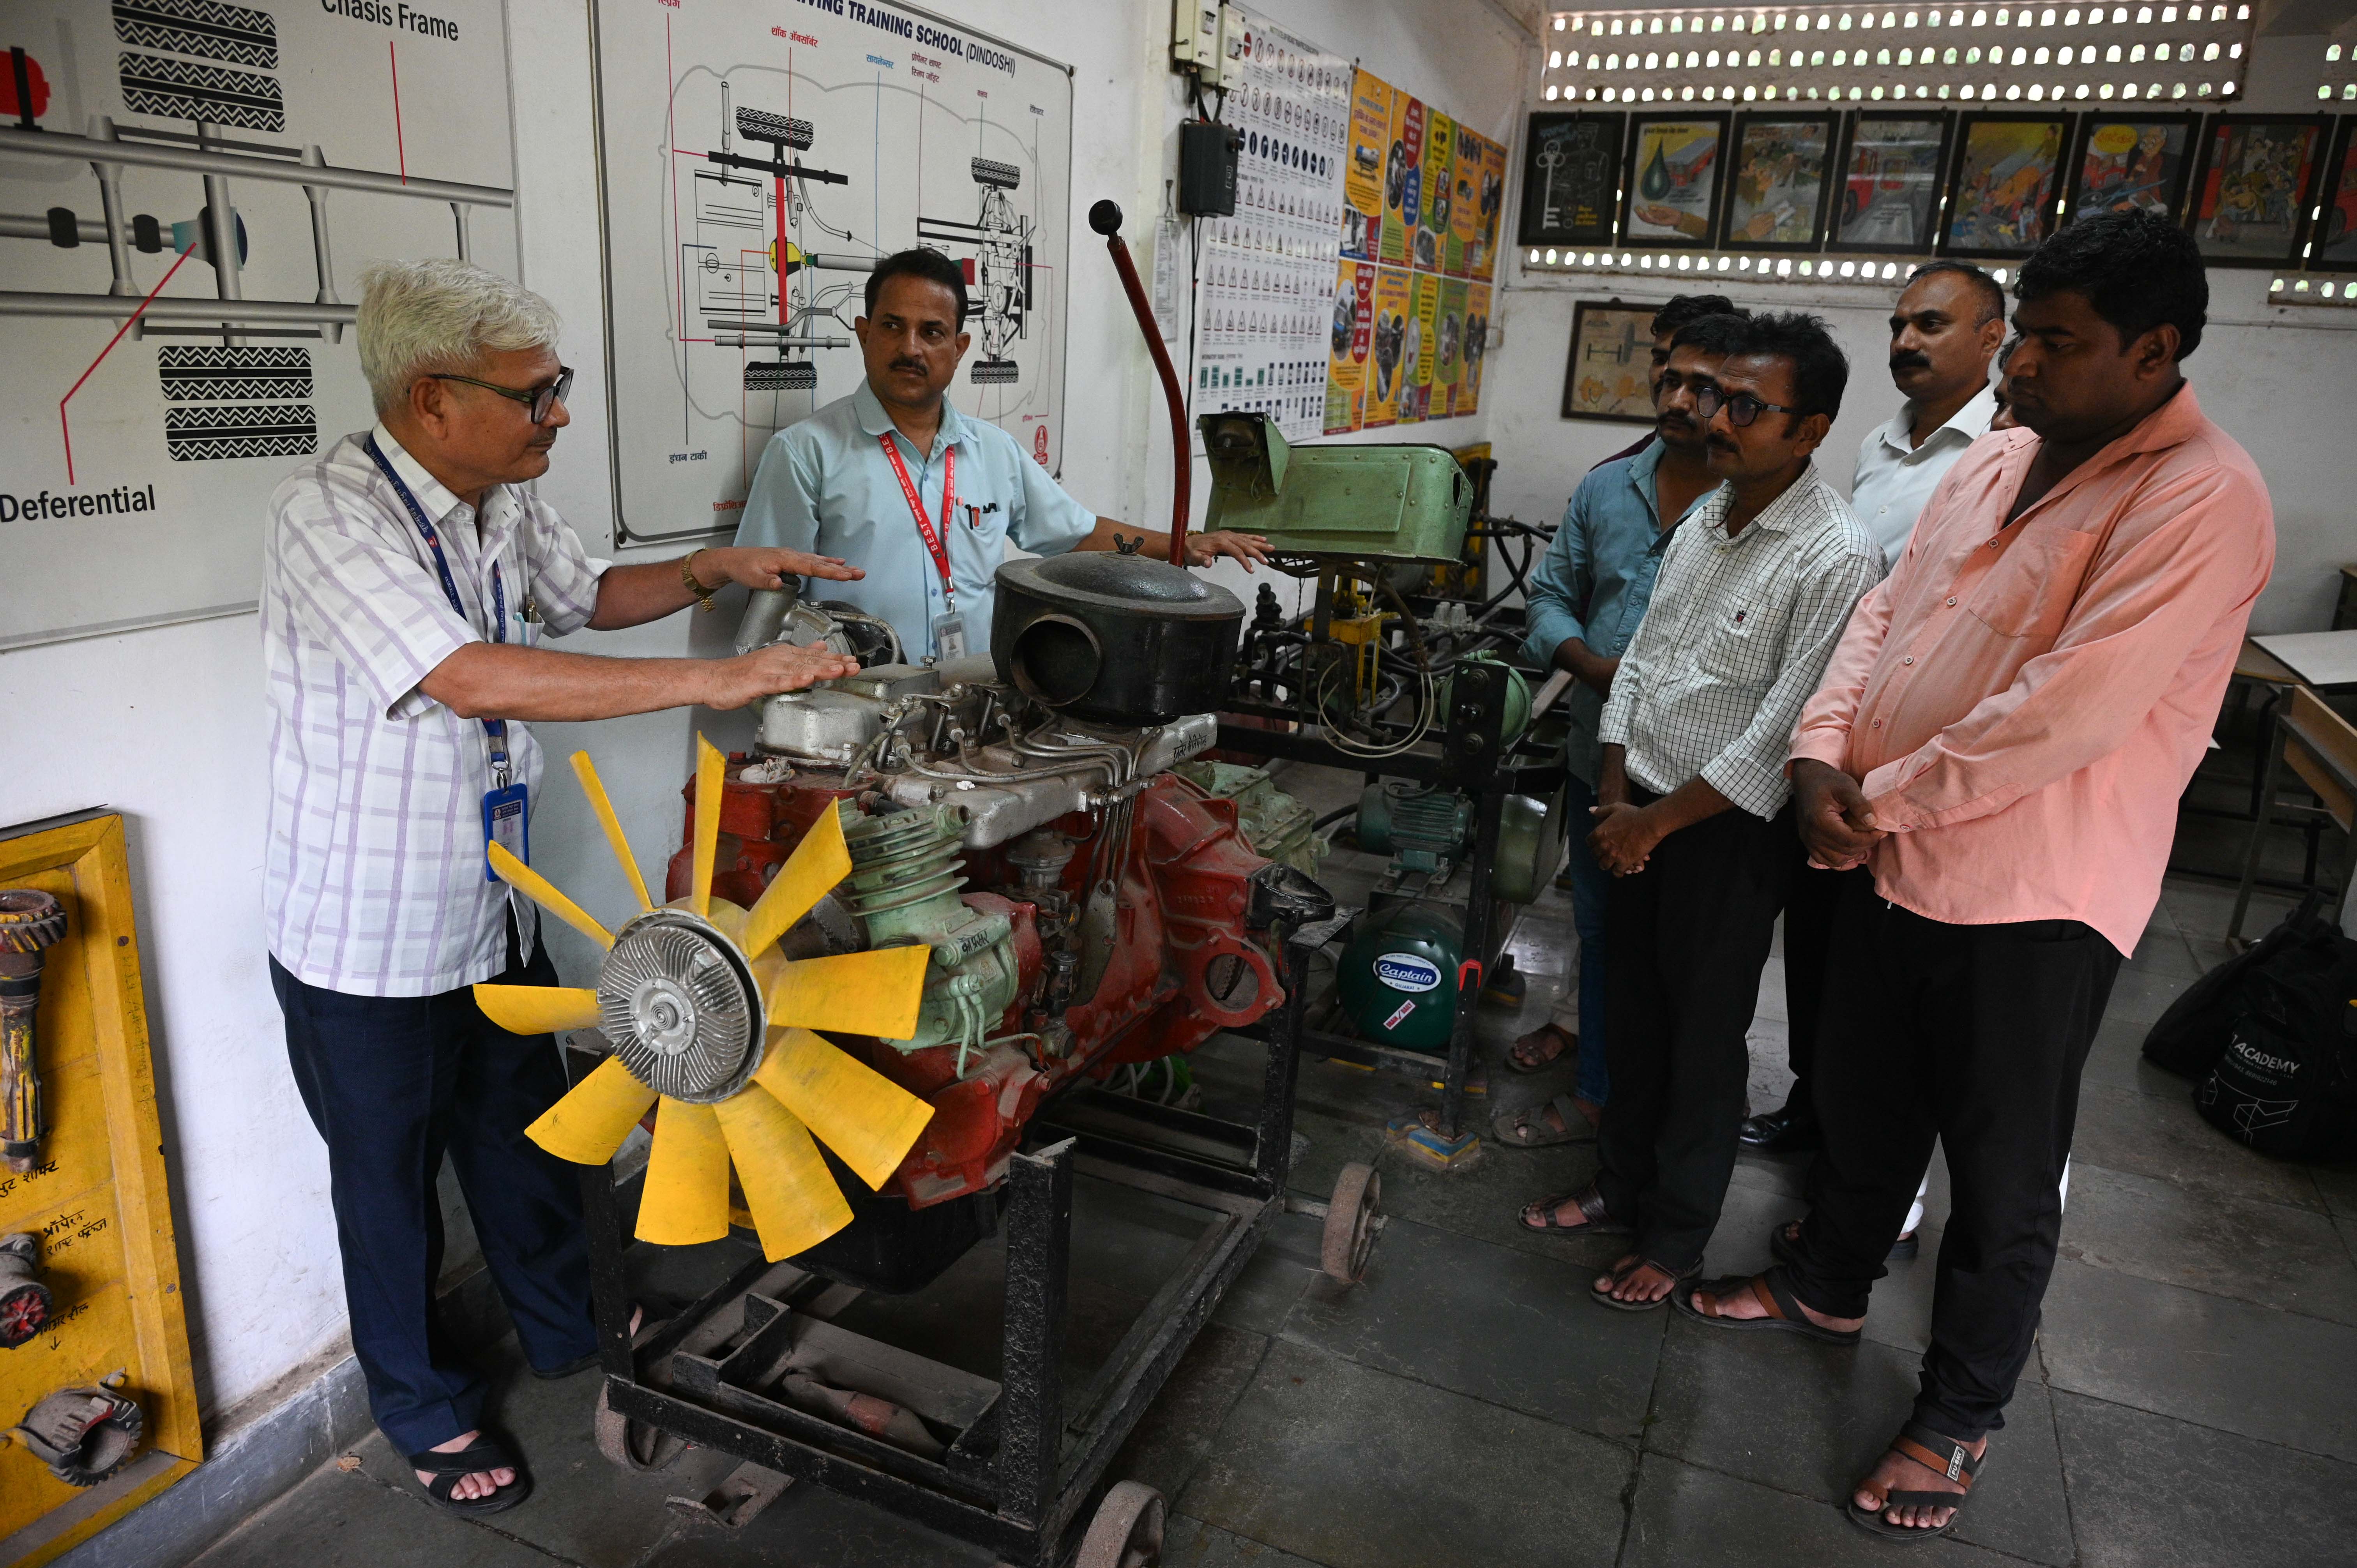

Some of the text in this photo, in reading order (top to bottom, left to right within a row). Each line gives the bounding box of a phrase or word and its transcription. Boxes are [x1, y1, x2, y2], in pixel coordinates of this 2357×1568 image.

[398, 3, 459, 41] Frame
[848, 0, 912, 39] TRAINING
[916, 26, 963, 56] SCHOOL
[966, 42, 1016, 78] (DINDOSHI)
[669, 453, 687, 464] इंधन
[0, 484, 156, 523] Deferential
[1379, 963, 1433, 982] Captain
[2234, 1042, 2300, 1074] ACADEMY
